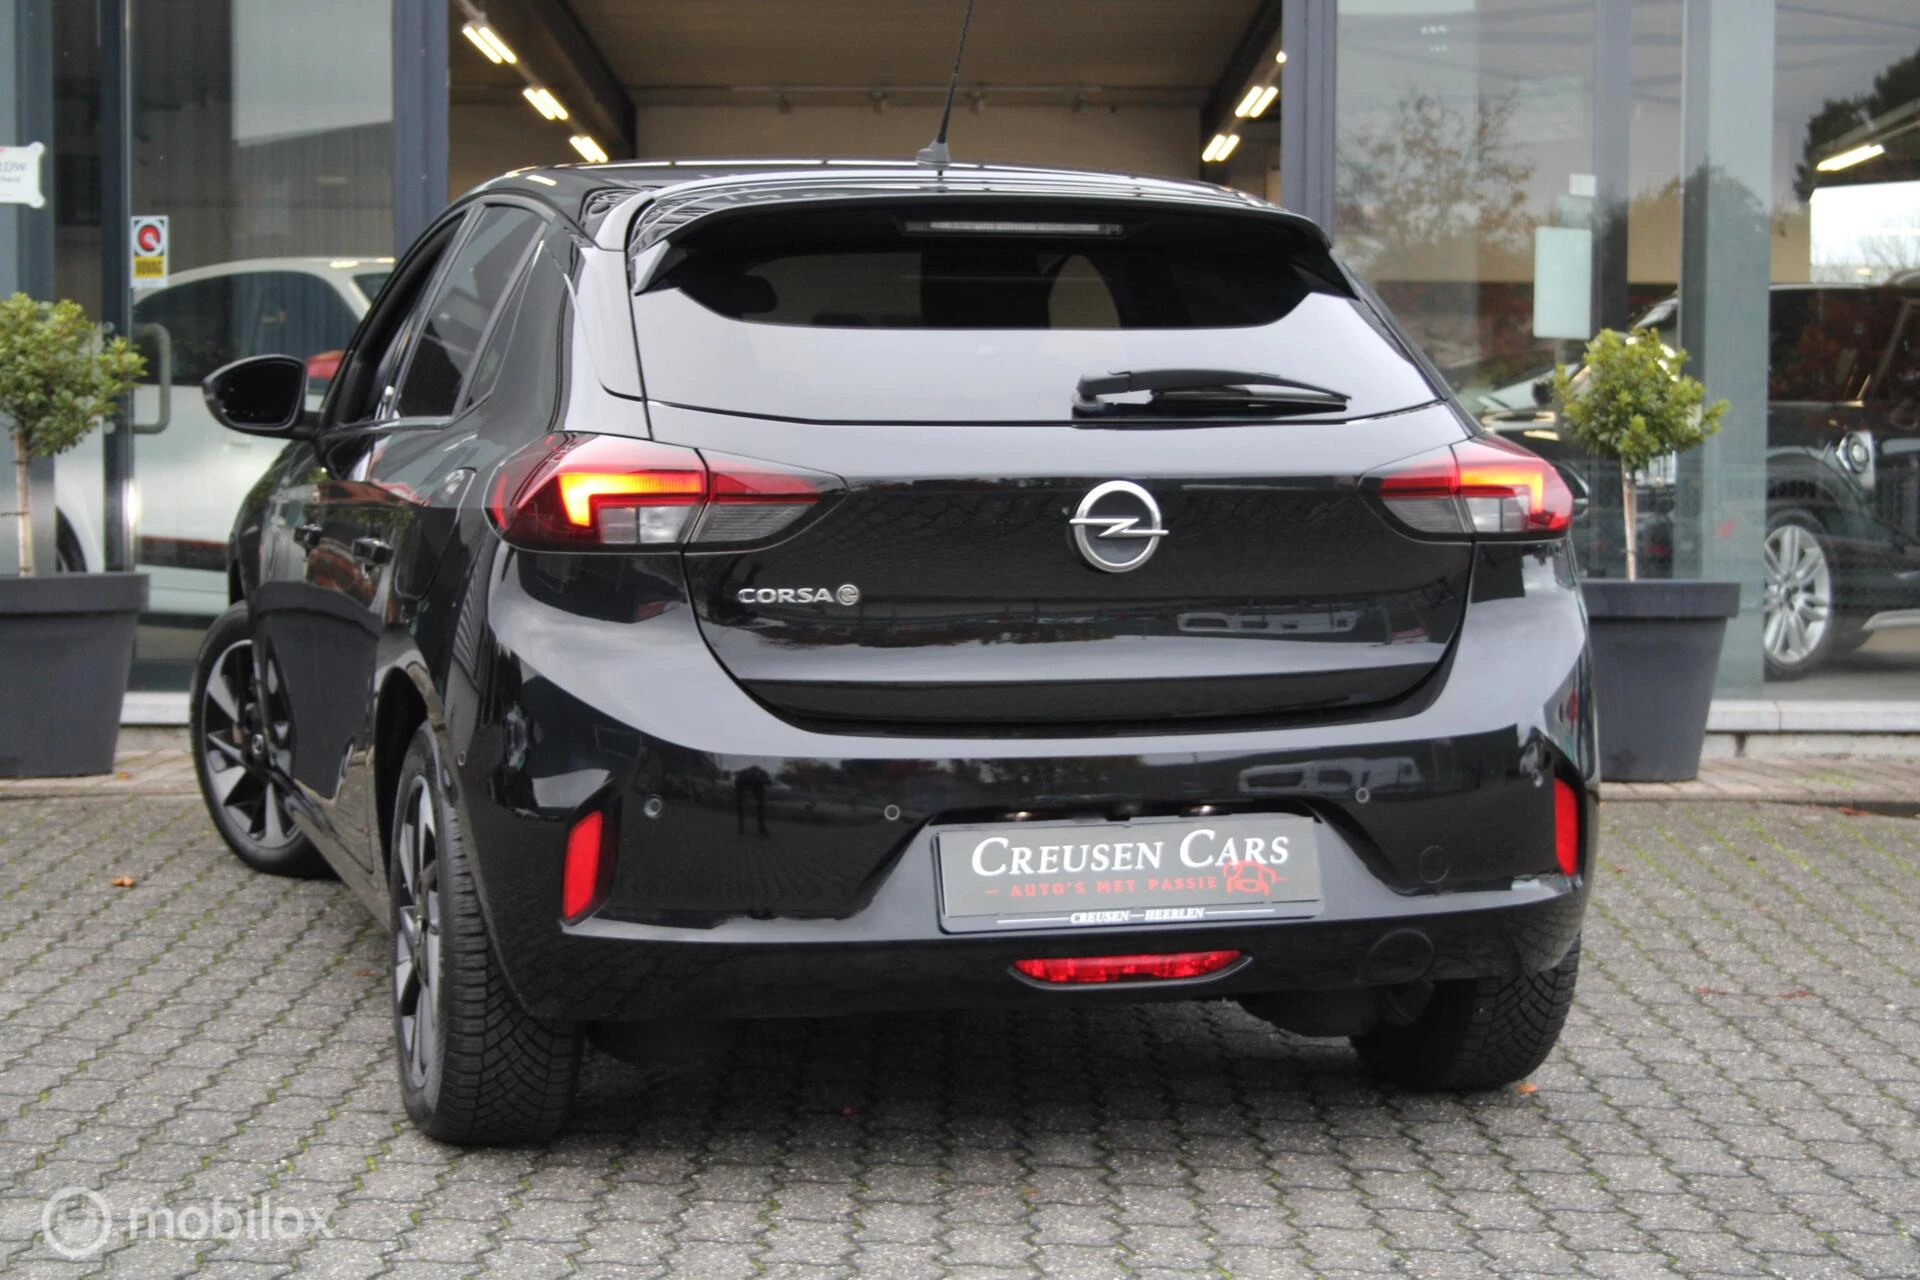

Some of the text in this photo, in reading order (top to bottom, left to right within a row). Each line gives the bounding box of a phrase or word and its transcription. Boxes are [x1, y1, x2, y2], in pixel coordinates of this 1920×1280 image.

[737, 587, 835, 604] CORSA
[971, 828, 1290, 877] CREUSEN CARS
[1010, 875, 1218, 898] AUTO'S MET PASSIE
[1070, 907, 1206, 925] CREUSEN HEERLEN
